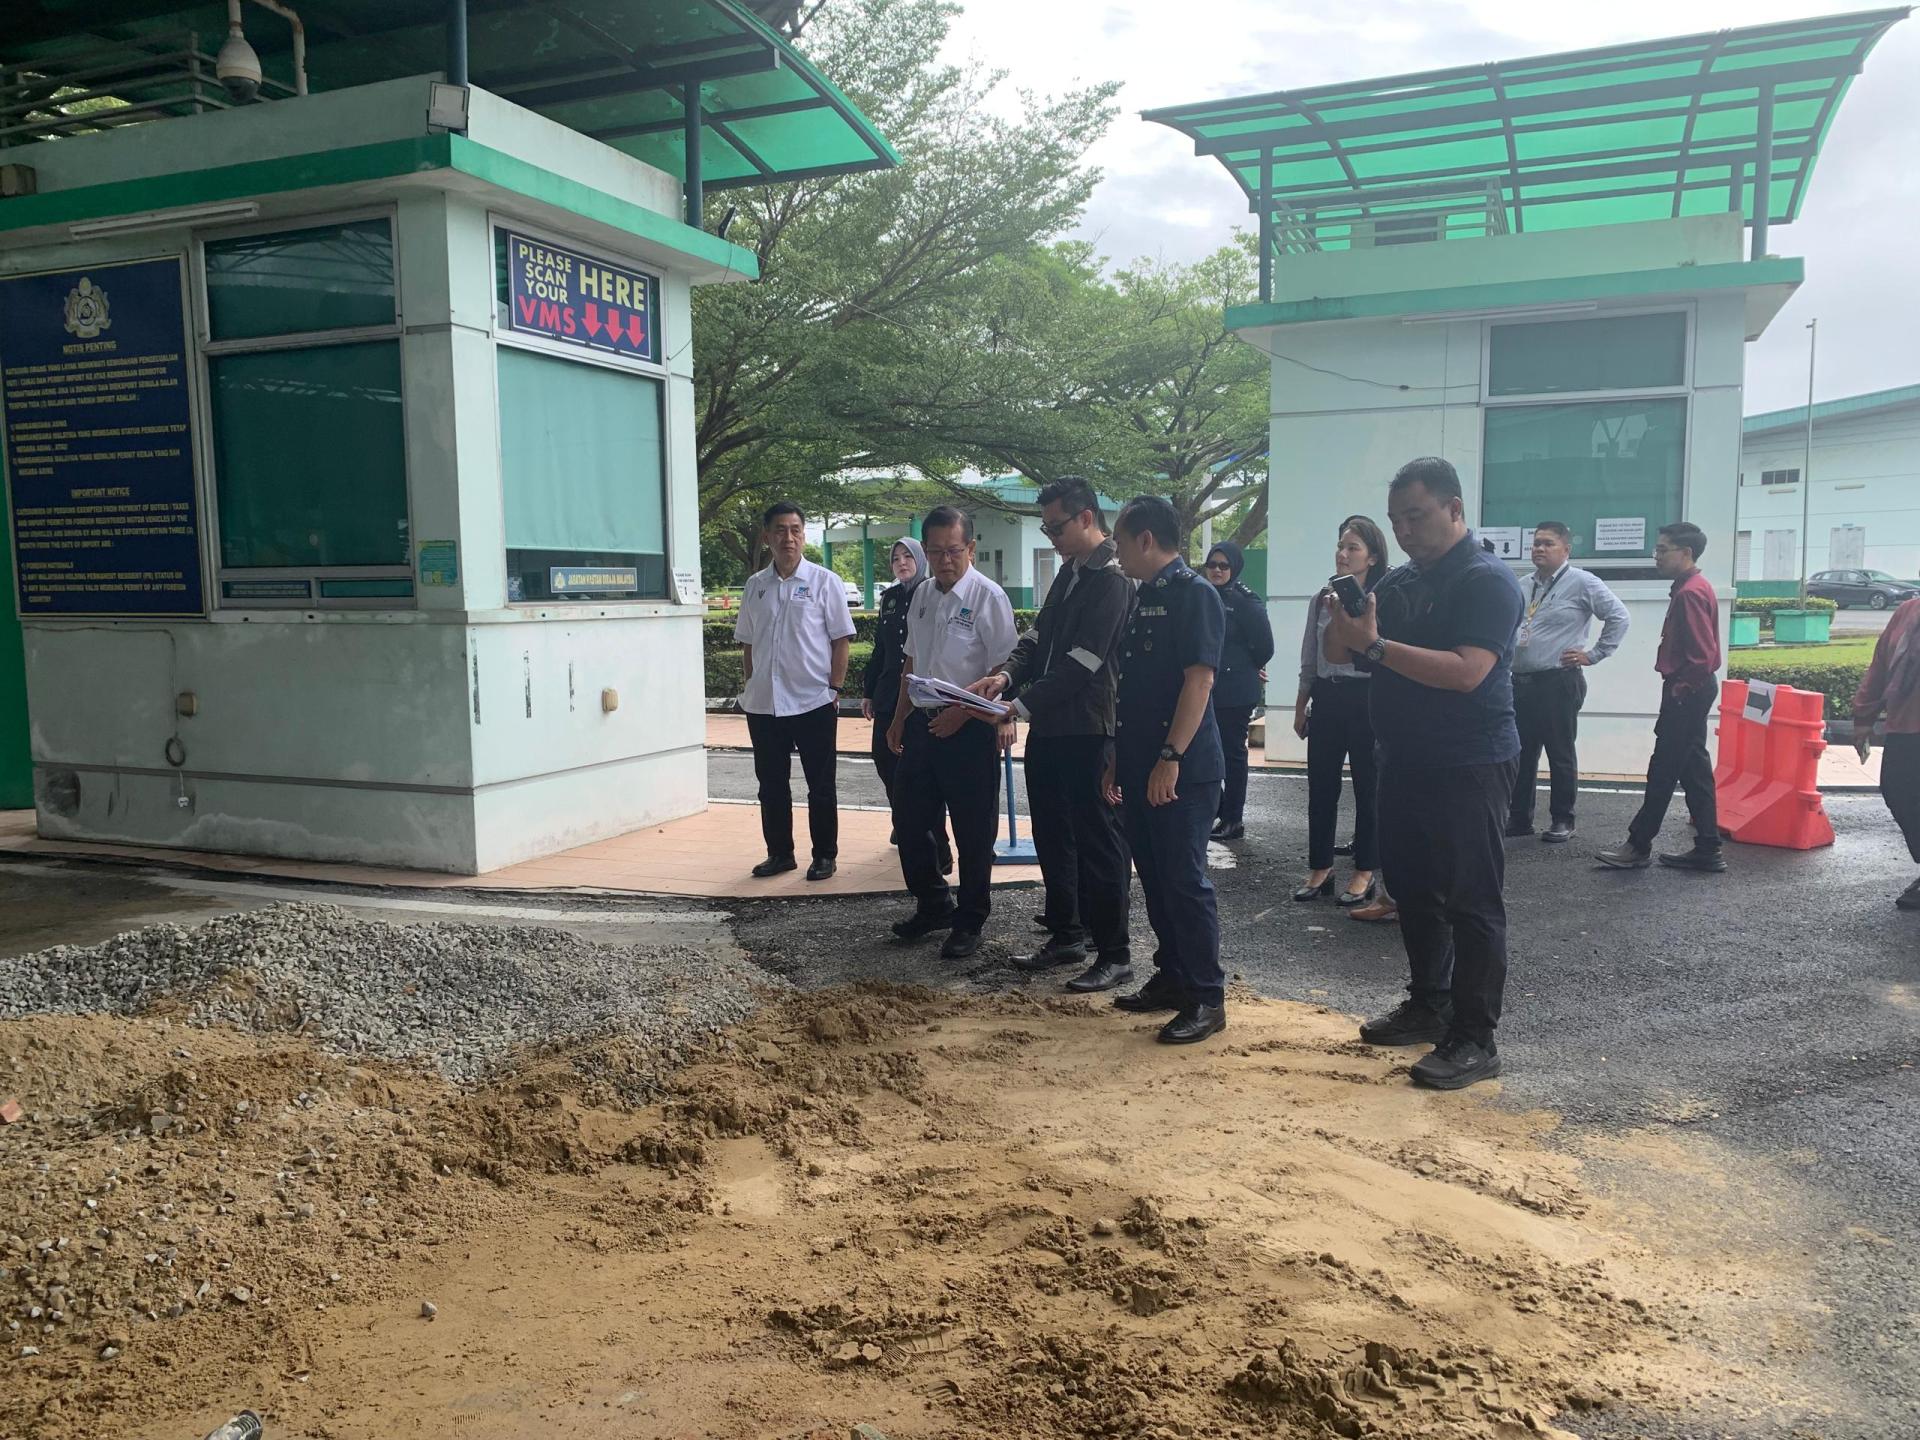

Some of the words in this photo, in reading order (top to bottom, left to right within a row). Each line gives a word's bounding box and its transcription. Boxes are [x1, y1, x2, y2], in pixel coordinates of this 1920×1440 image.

[519, 244, 572, 273] PLEASE
[526, 263, 566, 287] SCAN
[579, 264, 645, 311] HERE
[526, 279, 568, 304] YOUR
[518, 295, 576, 334] VMS
[63, 344, 83, 354] NOTIS
[85, 341, 116, 352] PENTING
[72, 488, 105, 498] IMPORTANT
[107, 487, 130, 497] NOTICE
